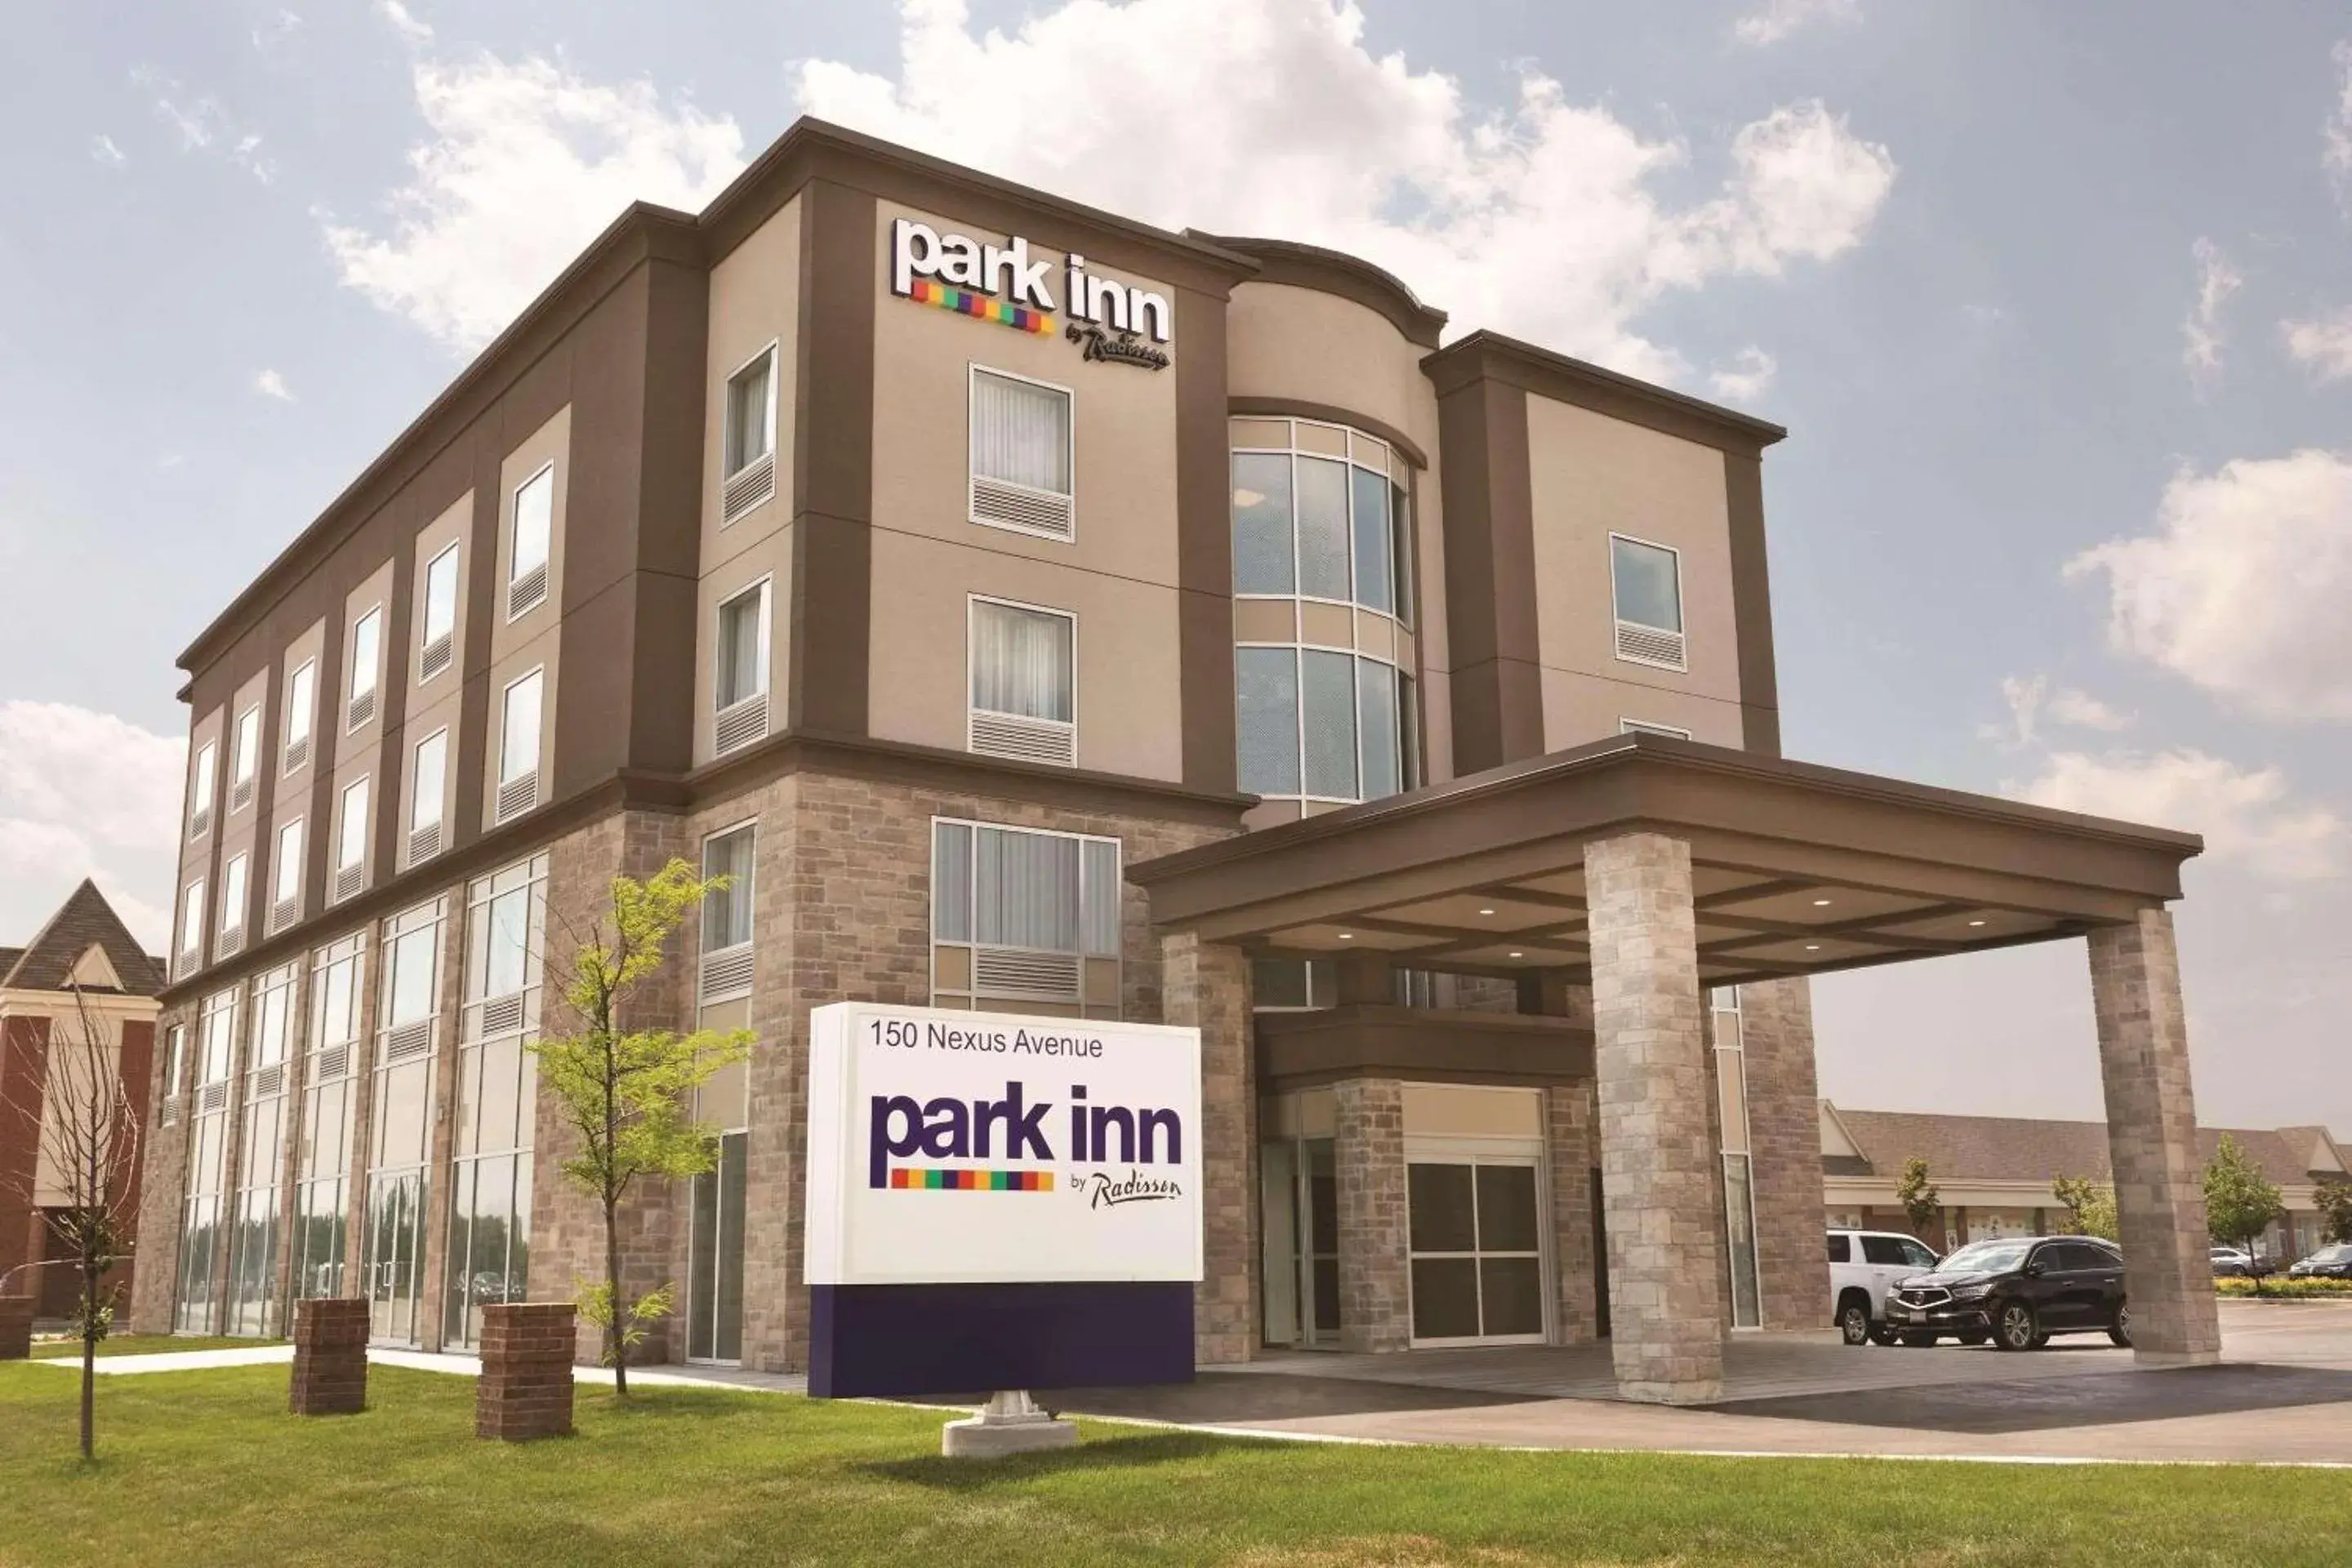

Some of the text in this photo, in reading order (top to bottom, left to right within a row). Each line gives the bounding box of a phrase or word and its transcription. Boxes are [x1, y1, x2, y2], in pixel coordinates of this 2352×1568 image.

[891, 218, 1169, 343] park inn
[871, 1019, 1103, 1058] 150 Nexus Avenue
[870, 1080, 1182, 1188] park inn
[1071, 1169, 1182, 1209] by Radisson
